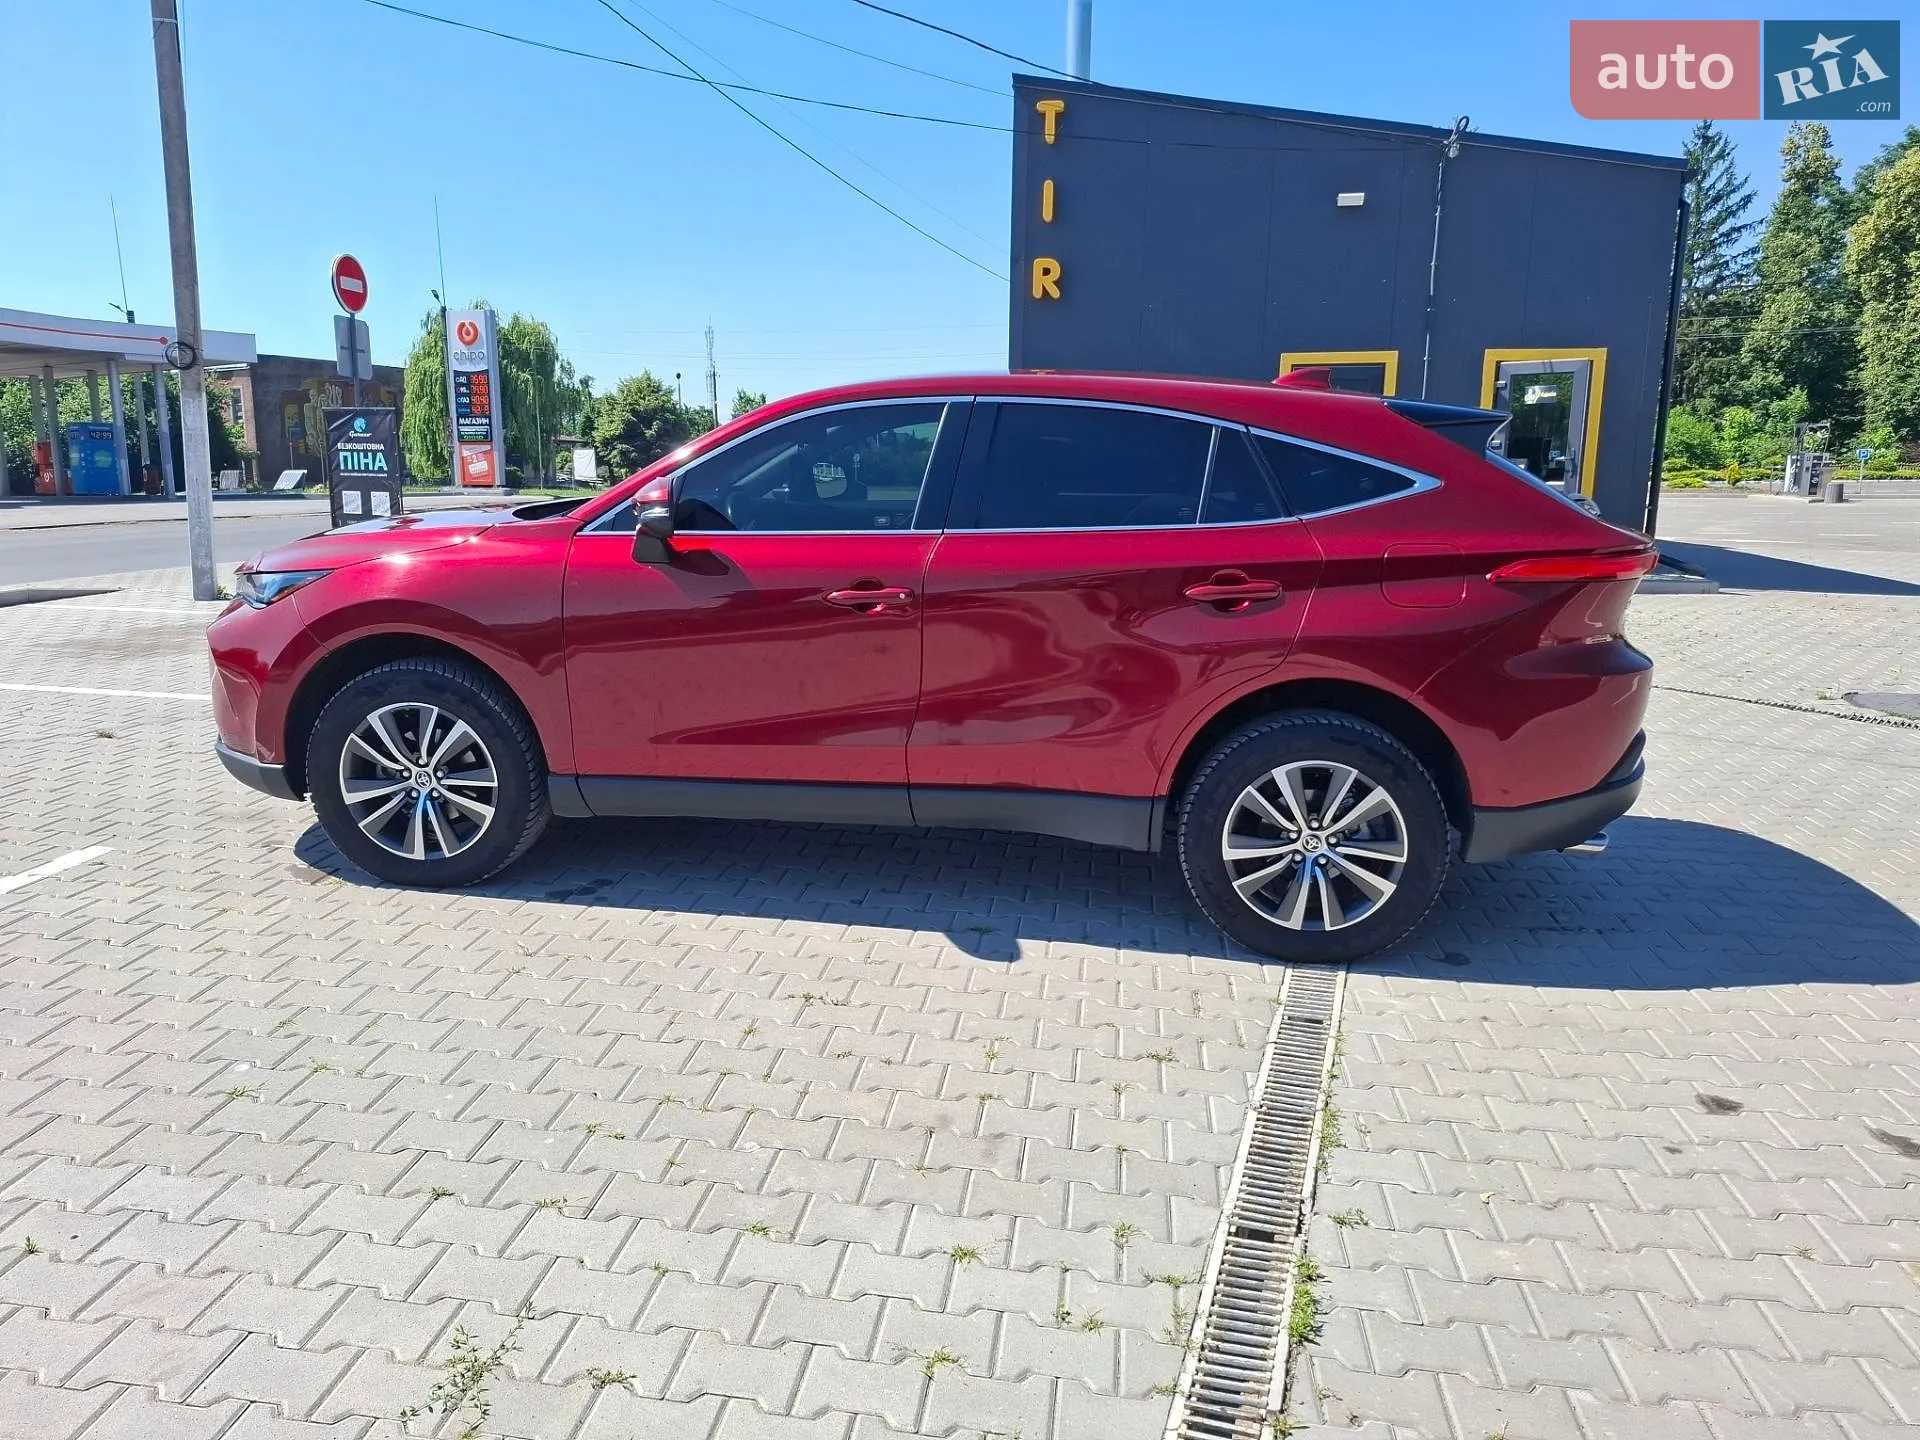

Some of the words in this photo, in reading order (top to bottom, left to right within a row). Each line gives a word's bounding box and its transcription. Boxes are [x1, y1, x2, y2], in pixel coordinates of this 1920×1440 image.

[453, 349, 485, 362] chipo
[458, 417, 490, 425] МАГАЗИН
[339, 451, 388, 471] ПІНА
